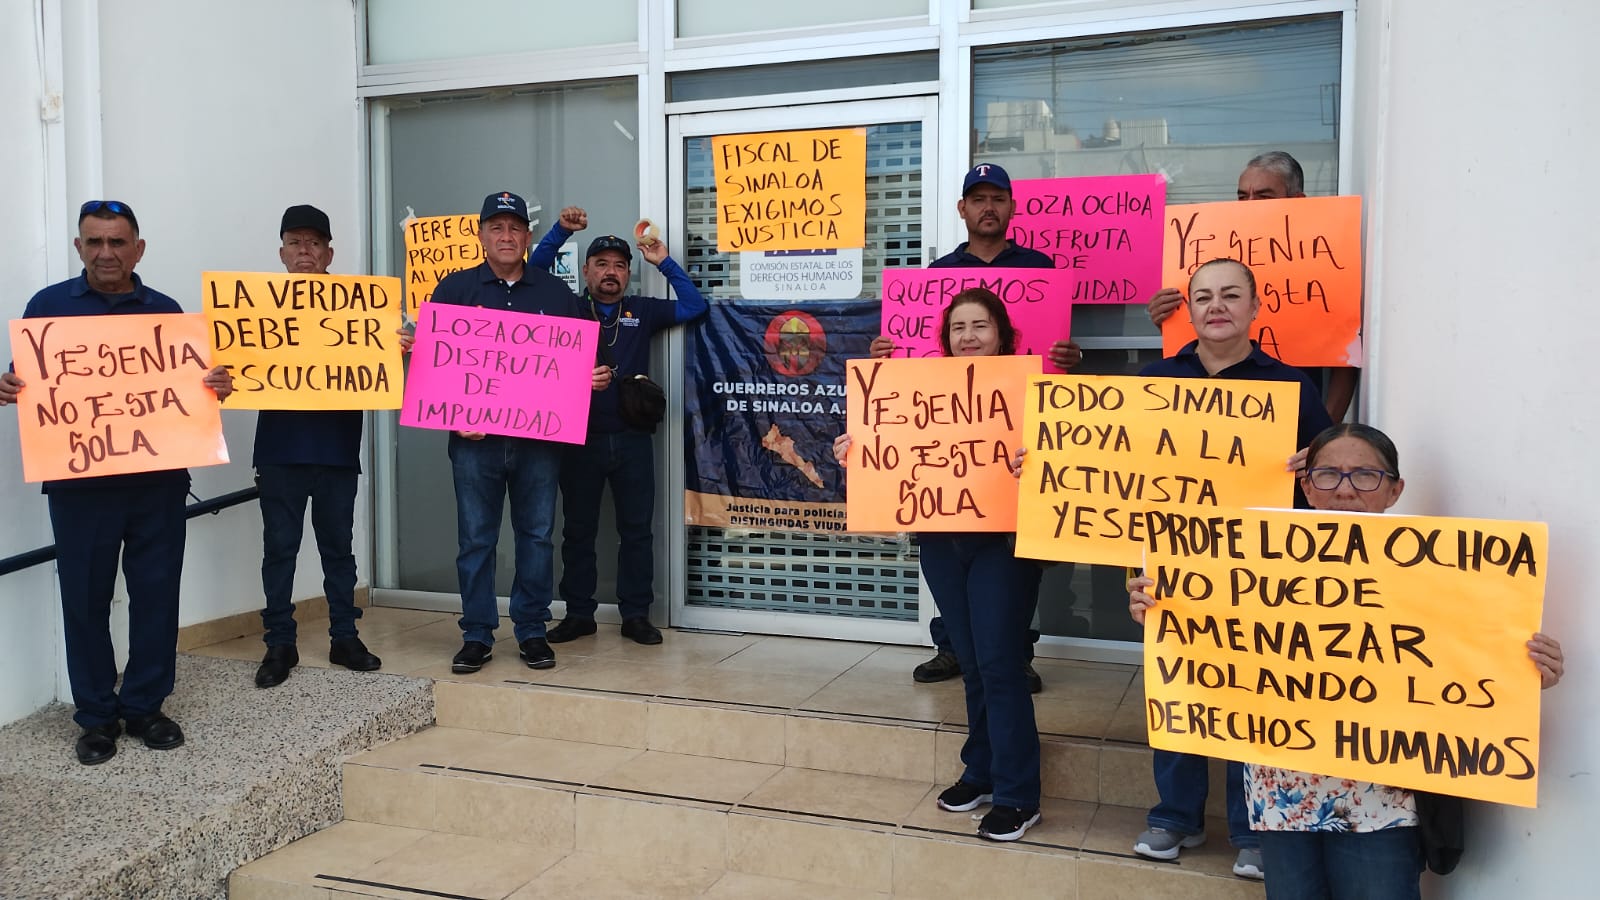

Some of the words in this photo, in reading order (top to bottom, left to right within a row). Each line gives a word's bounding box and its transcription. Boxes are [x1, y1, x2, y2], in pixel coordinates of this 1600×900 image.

[722, 141, 800, 171] FISCAL
[812, 138, 842, 162] DE
[976, 165, 990, 176] T
[724, 168, 823, 197] SINALOA
[723, 193, 843, 224] EXIGIMOS
[1081, 191, 1152, 219] OCHOA
[410, 218, 451, 244] TERE
[730, 219, 839, 249] JUSTICIA
[1012, 226, 1132, 252] DISFRUTA
[411, 270, 429, 284] AL
[749, 261, 789, 271] COMISIÓN
[790, 261, 823, 270] ESTATAL
[825, 261, 837, 269] DE
[838, 260, 853, 268] LOS
[750, 272, 799, 282] DERECHOS
[801, 271, 853, 280] HUMANOS
[1052, 253, 1088, 269] DE
[210, 280, 255, 309] LA
[267, 279, 389, 312] VERDAD
[775, 283, 826, 291] SINALOA
[213, 317, 300, 351] DEBE
[319, 317, 385, 351] SER
[431, 310, 506, 343] LOZA
[511, 323, 582, 352] OCHOA
[887, 314, 934, 339] QUE
[21, 321, 209, 386] YESENIA
[433, 340, 560, 381] DISFRUTA
[464, 372, 501, 396] DE
[713, 382, 809, 395] GUERREROS
[814, 384, 847, 396] AZU
[851, 362, 1014, 433] YESENIA
[36, 386, 79, 427] NO
[84, 387, 190, 429] ESTA
[417, 399, 562, 437] IMPUNIDAD
[726, 399, 748, 412] DE
[752, 400, 824, 413] SINALOA
[1033, 380, 1125, 414] TODO
[1143, 382, 1276, 424] SINALOA
[68, 424, 159, 474] SOLA
[862, 435, 899, 471] NO
[910, 440, 1014, 482] ESTA
[1036, 420, 1132, 452] APOYA
[1156, 428, 1177, 456] A
[1200, 429, 1246, 467] LA
[1039, 461, 1218, 507] ACTIVISTA
[726, 503, 770, 513] Justicia
[774, 507, 800, 516] para
[895, 480, 987, 526] SOLA
[730, 516, 810, 529] DISTINGUIDAS
[1052, 500, 1145, 542] YESE
[1145, 510, 1246, 560] PROFE
[1259, 520, 1370, 565] LOZA
[1384, 526, 1537, 577] OCHOA
[1154, 565, 1213, 601] NO
[1230, 567, 1384, 609] PUEDE
[1156, 609, 1433, 668] AMENAZAR
[1156, 656, 1378, 703] VIOLANDO
[1407, 675, 1497, 709] LOS
[1149, 698, 1316, 750] DERECHOS
[1334, 719, 1536, 781] HUMANOS
